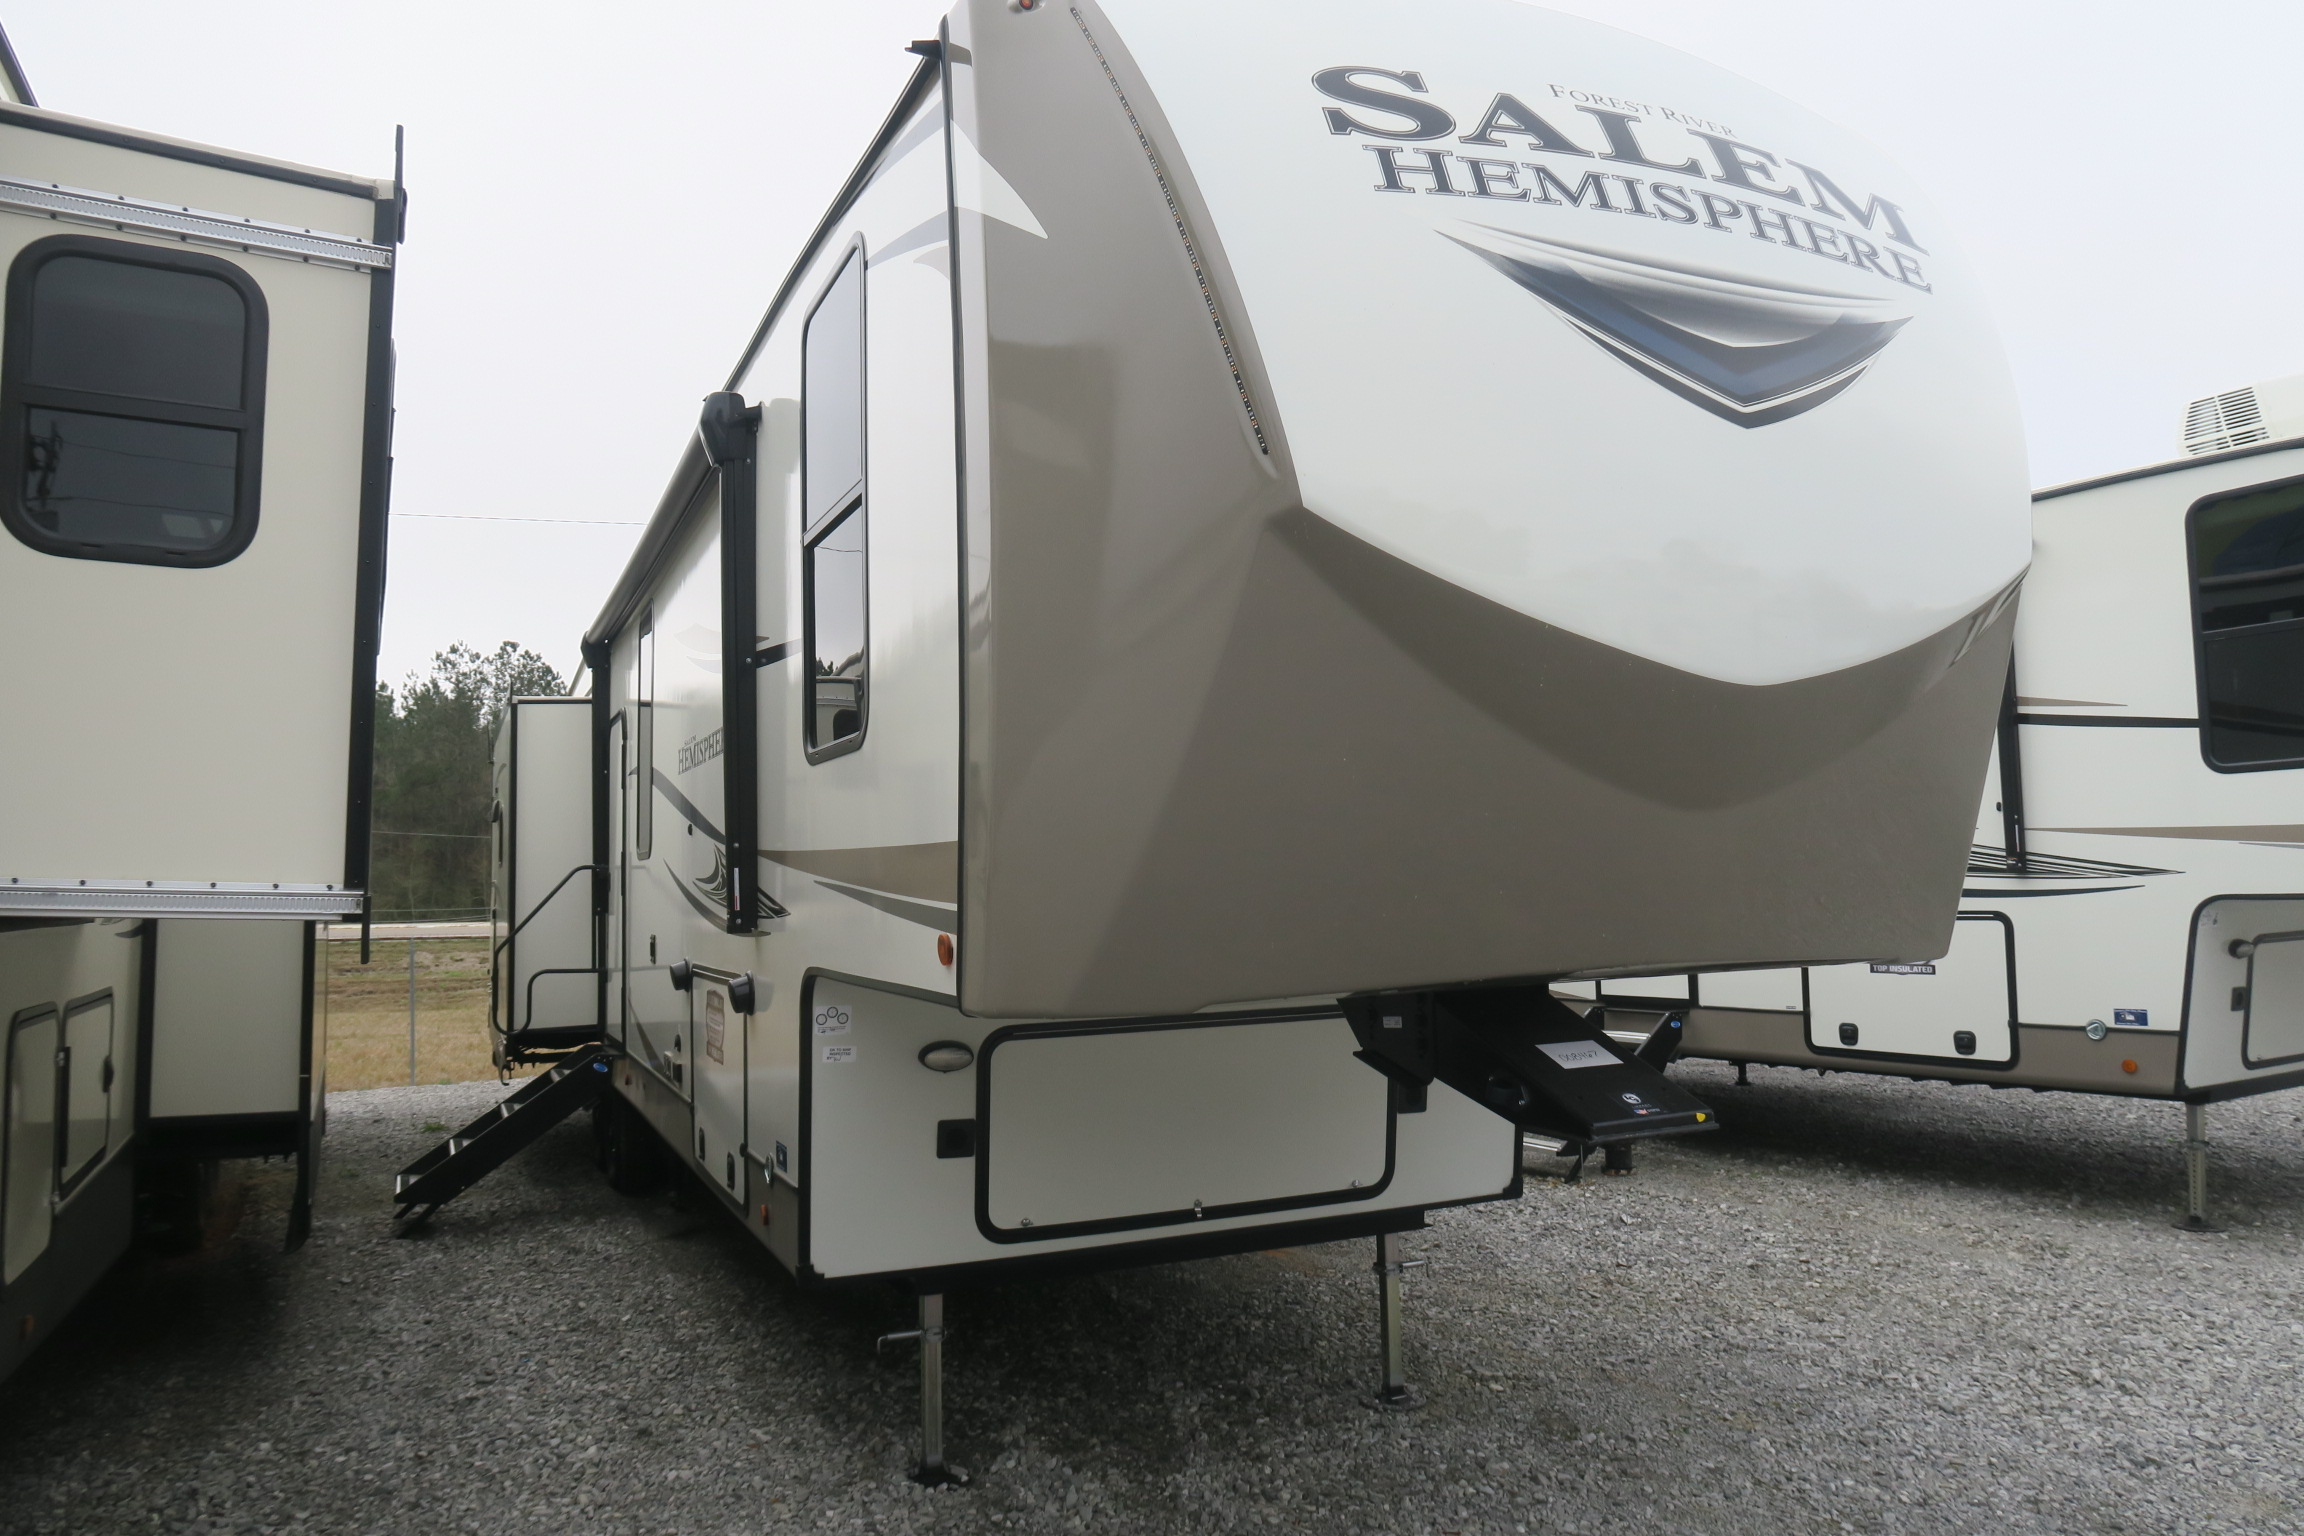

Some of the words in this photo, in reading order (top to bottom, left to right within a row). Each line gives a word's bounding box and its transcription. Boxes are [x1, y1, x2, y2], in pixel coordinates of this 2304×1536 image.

[1311, 66, 1931, 257] SALEM
[1547, 84, 1653, 116] FOREST
[1659, 107, 1738, 139] RIVER
[1361, 145, 1933, 295] HEMISPHERE
[1889, 965, 1933, 973] INSULATED
